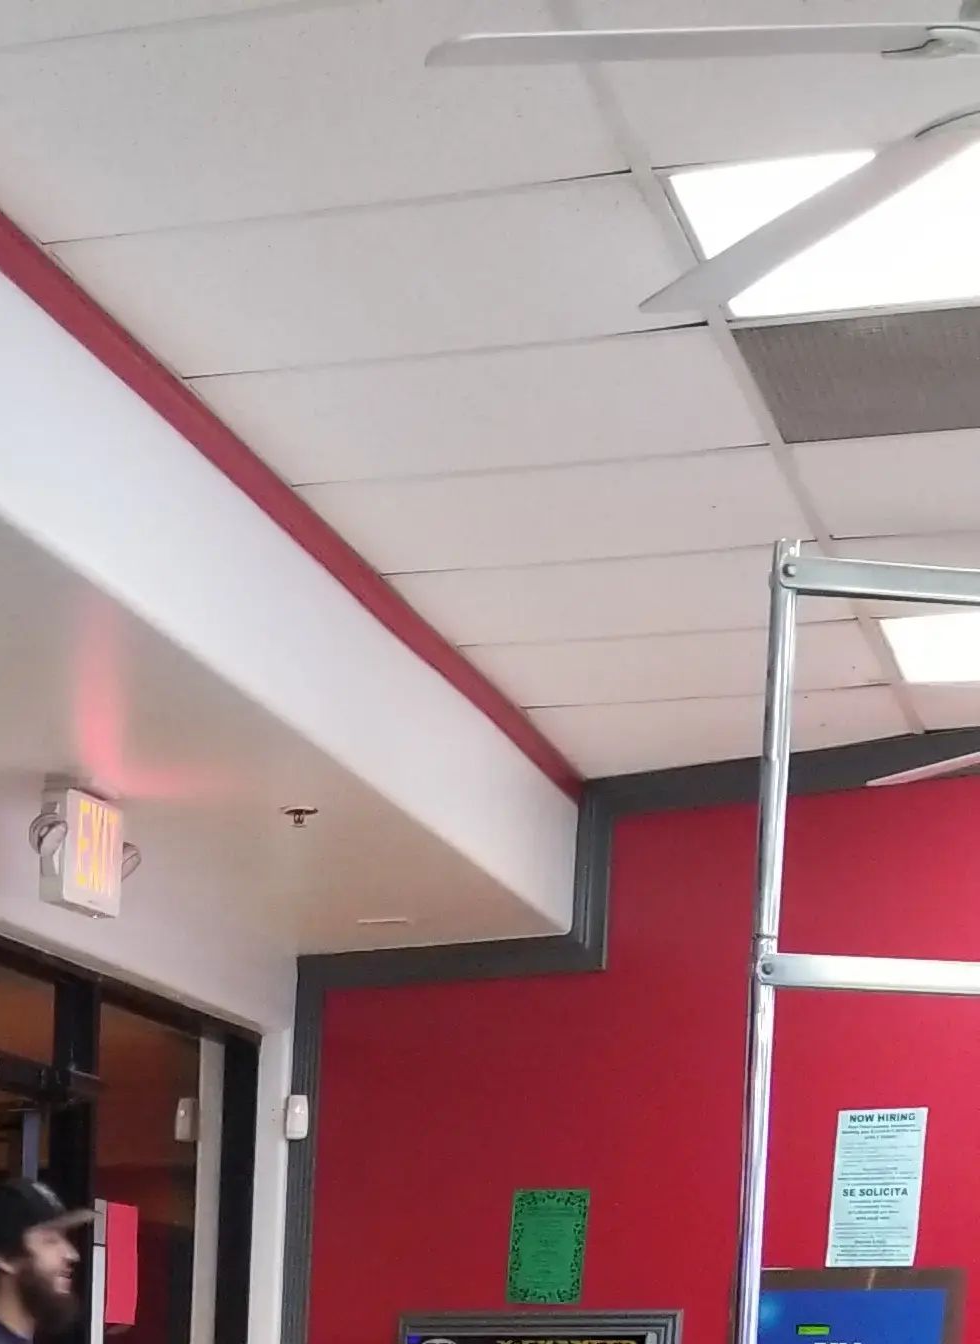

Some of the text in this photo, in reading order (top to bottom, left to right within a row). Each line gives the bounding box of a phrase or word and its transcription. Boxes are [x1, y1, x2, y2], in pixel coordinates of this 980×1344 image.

[76, 799, 118, 898] EXIT
[849, 1112, 916, 1123] NOW HIRING
[842, 1187, 909, 1197] SE SOLICITA
